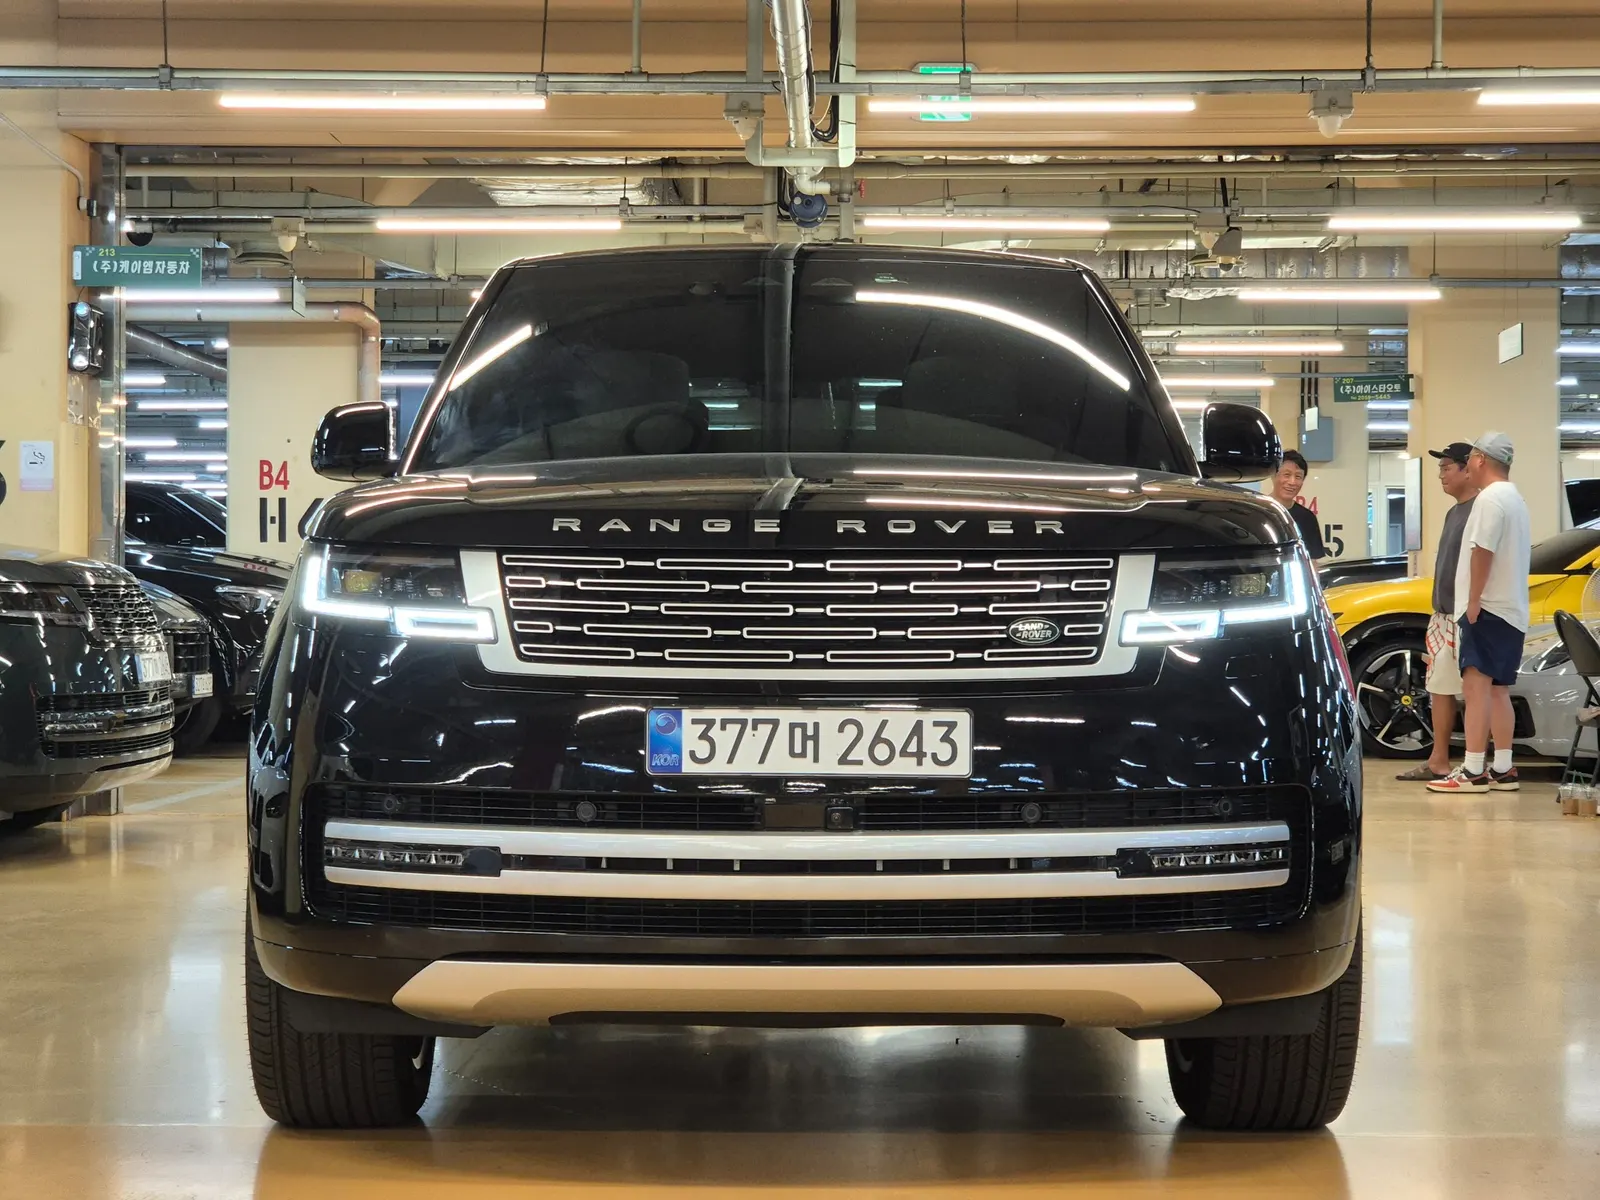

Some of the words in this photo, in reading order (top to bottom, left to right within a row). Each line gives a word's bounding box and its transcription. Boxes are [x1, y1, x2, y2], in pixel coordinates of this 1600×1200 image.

[98, 248, 116, 257] 213
[92, 260, 191, 275] (주)케이엠자동차
[259, 460, 290, 490] B4
[552, 518, 781, 533] RANGE
[836, 519, 1065, 534] ROVER
[1018, 622, 1044, 631] LAND
[1021, 629, 1052, 639] ROVER
[837, 719, 959, 767] 2643
[651, 753, 680, 766] KOR
